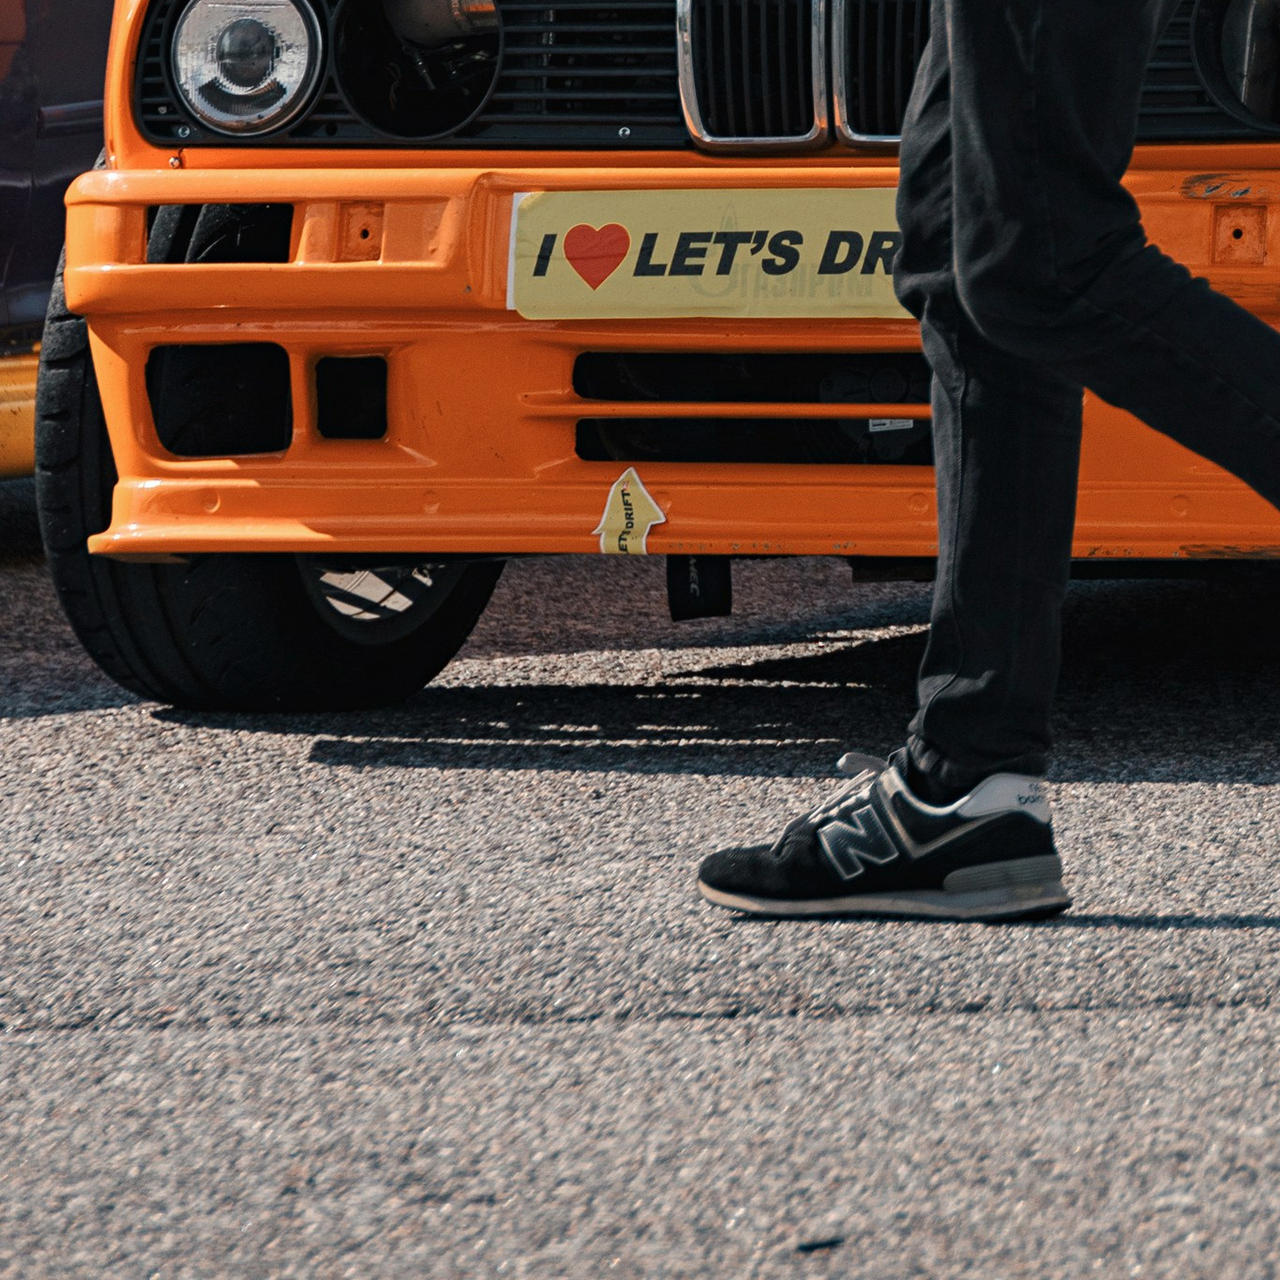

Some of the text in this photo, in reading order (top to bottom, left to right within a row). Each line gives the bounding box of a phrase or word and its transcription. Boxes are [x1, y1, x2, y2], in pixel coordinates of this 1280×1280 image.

[532, 230, 903, 277] I LET'S DR
[620, 488, 635, 531] DRIFT
